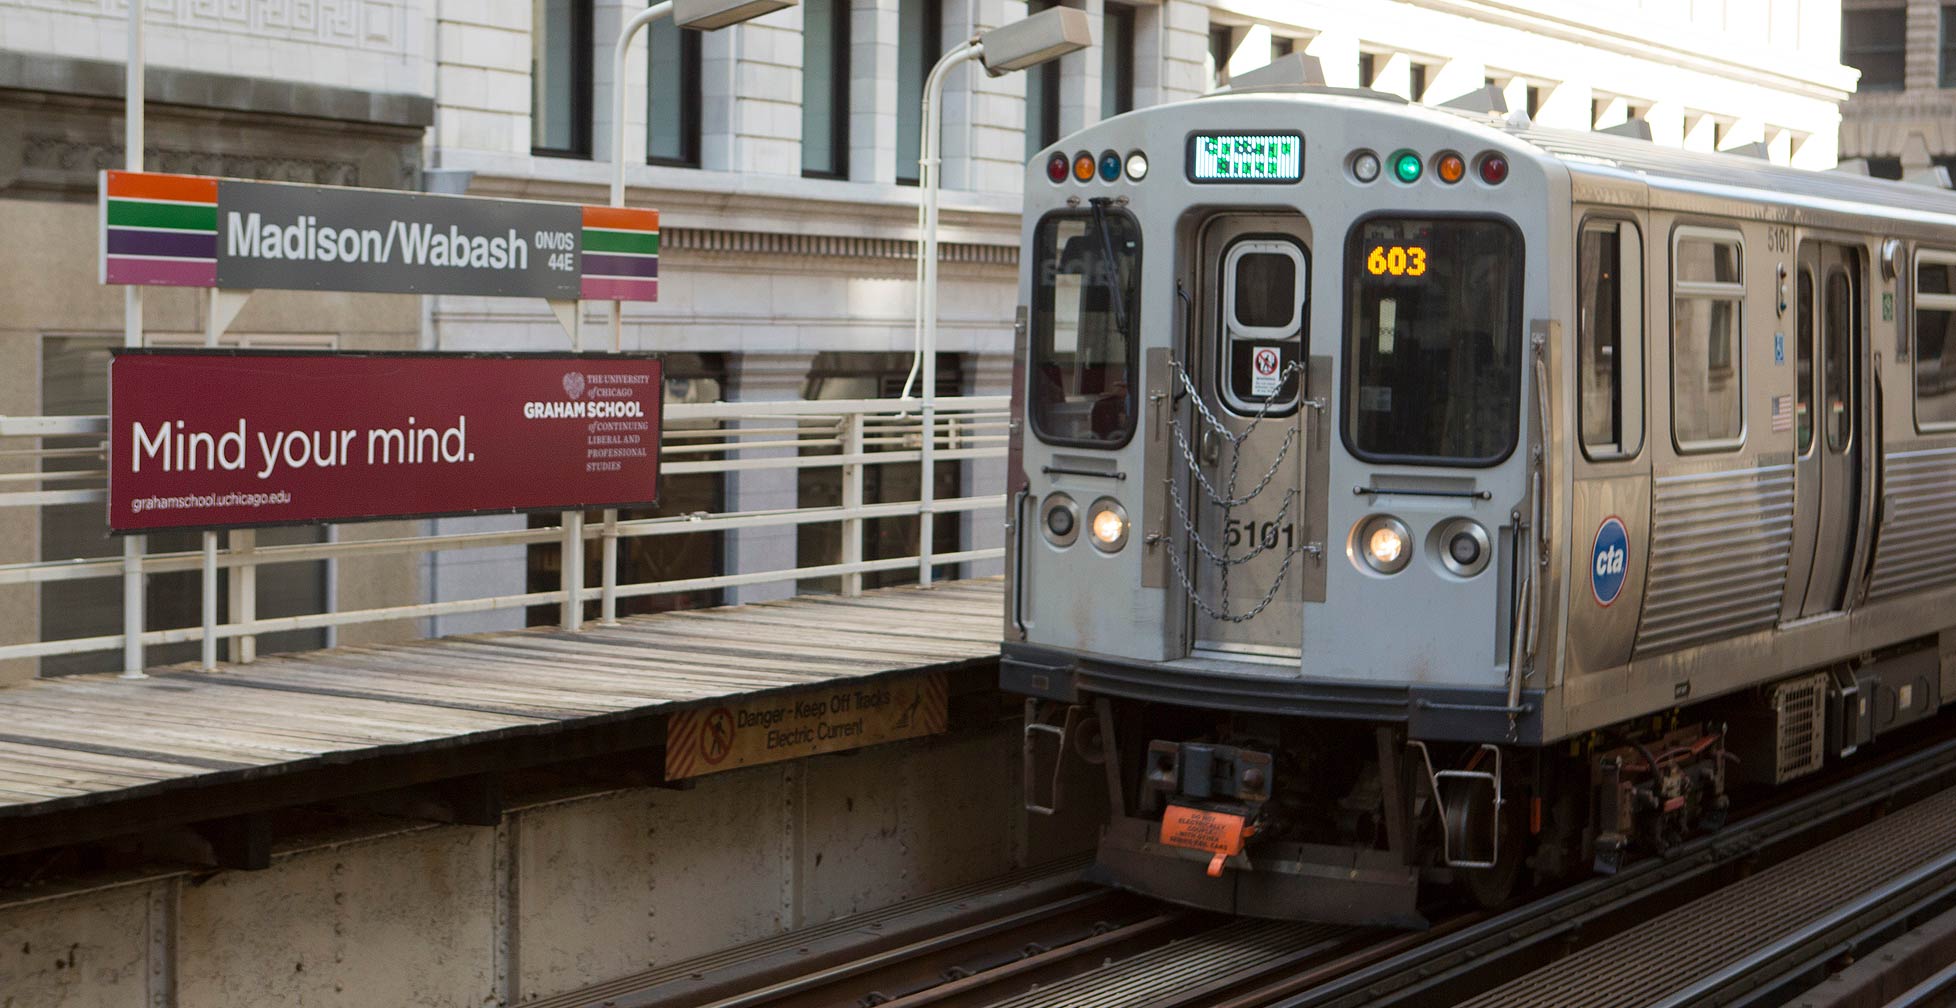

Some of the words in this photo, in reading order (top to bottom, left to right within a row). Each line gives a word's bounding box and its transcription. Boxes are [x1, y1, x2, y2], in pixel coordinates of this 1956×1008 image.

[227, 211, 528, 270] Madison/Wabash
[1767, 225, 1790, 254] 5101
[548, 253, 574, 271] 44E
[1367, 246, 1427, 276] 603
[587, 374, 604, 384] THE
[604, 374, 650, 384] UNIVERSITY
[524, 402, 586, 419] GRAHAM
[587, 401, 644, 418] SCHOOL
[131, 418, 247, 473] Mind
[257, 428, 357, 479] your
[367, 415, 476, 465] mind.
[587, 435, 623, 445] LIBERAL
[623, 434, 641, 444] AND
[586, 448, 647, 458] PROFESSIONAL
[586, 461, 622, 472] STUDIES
[131, 490, 292, 513] grahamschool.uchicago.edu
[1227, 519, 1294, 549] 5101
[1596, 544, 1624, 577] cta
[830, 694, 851, 713] Off
[766, 726, 814, 750] Electric
[817, 717, 864, 740] Current
